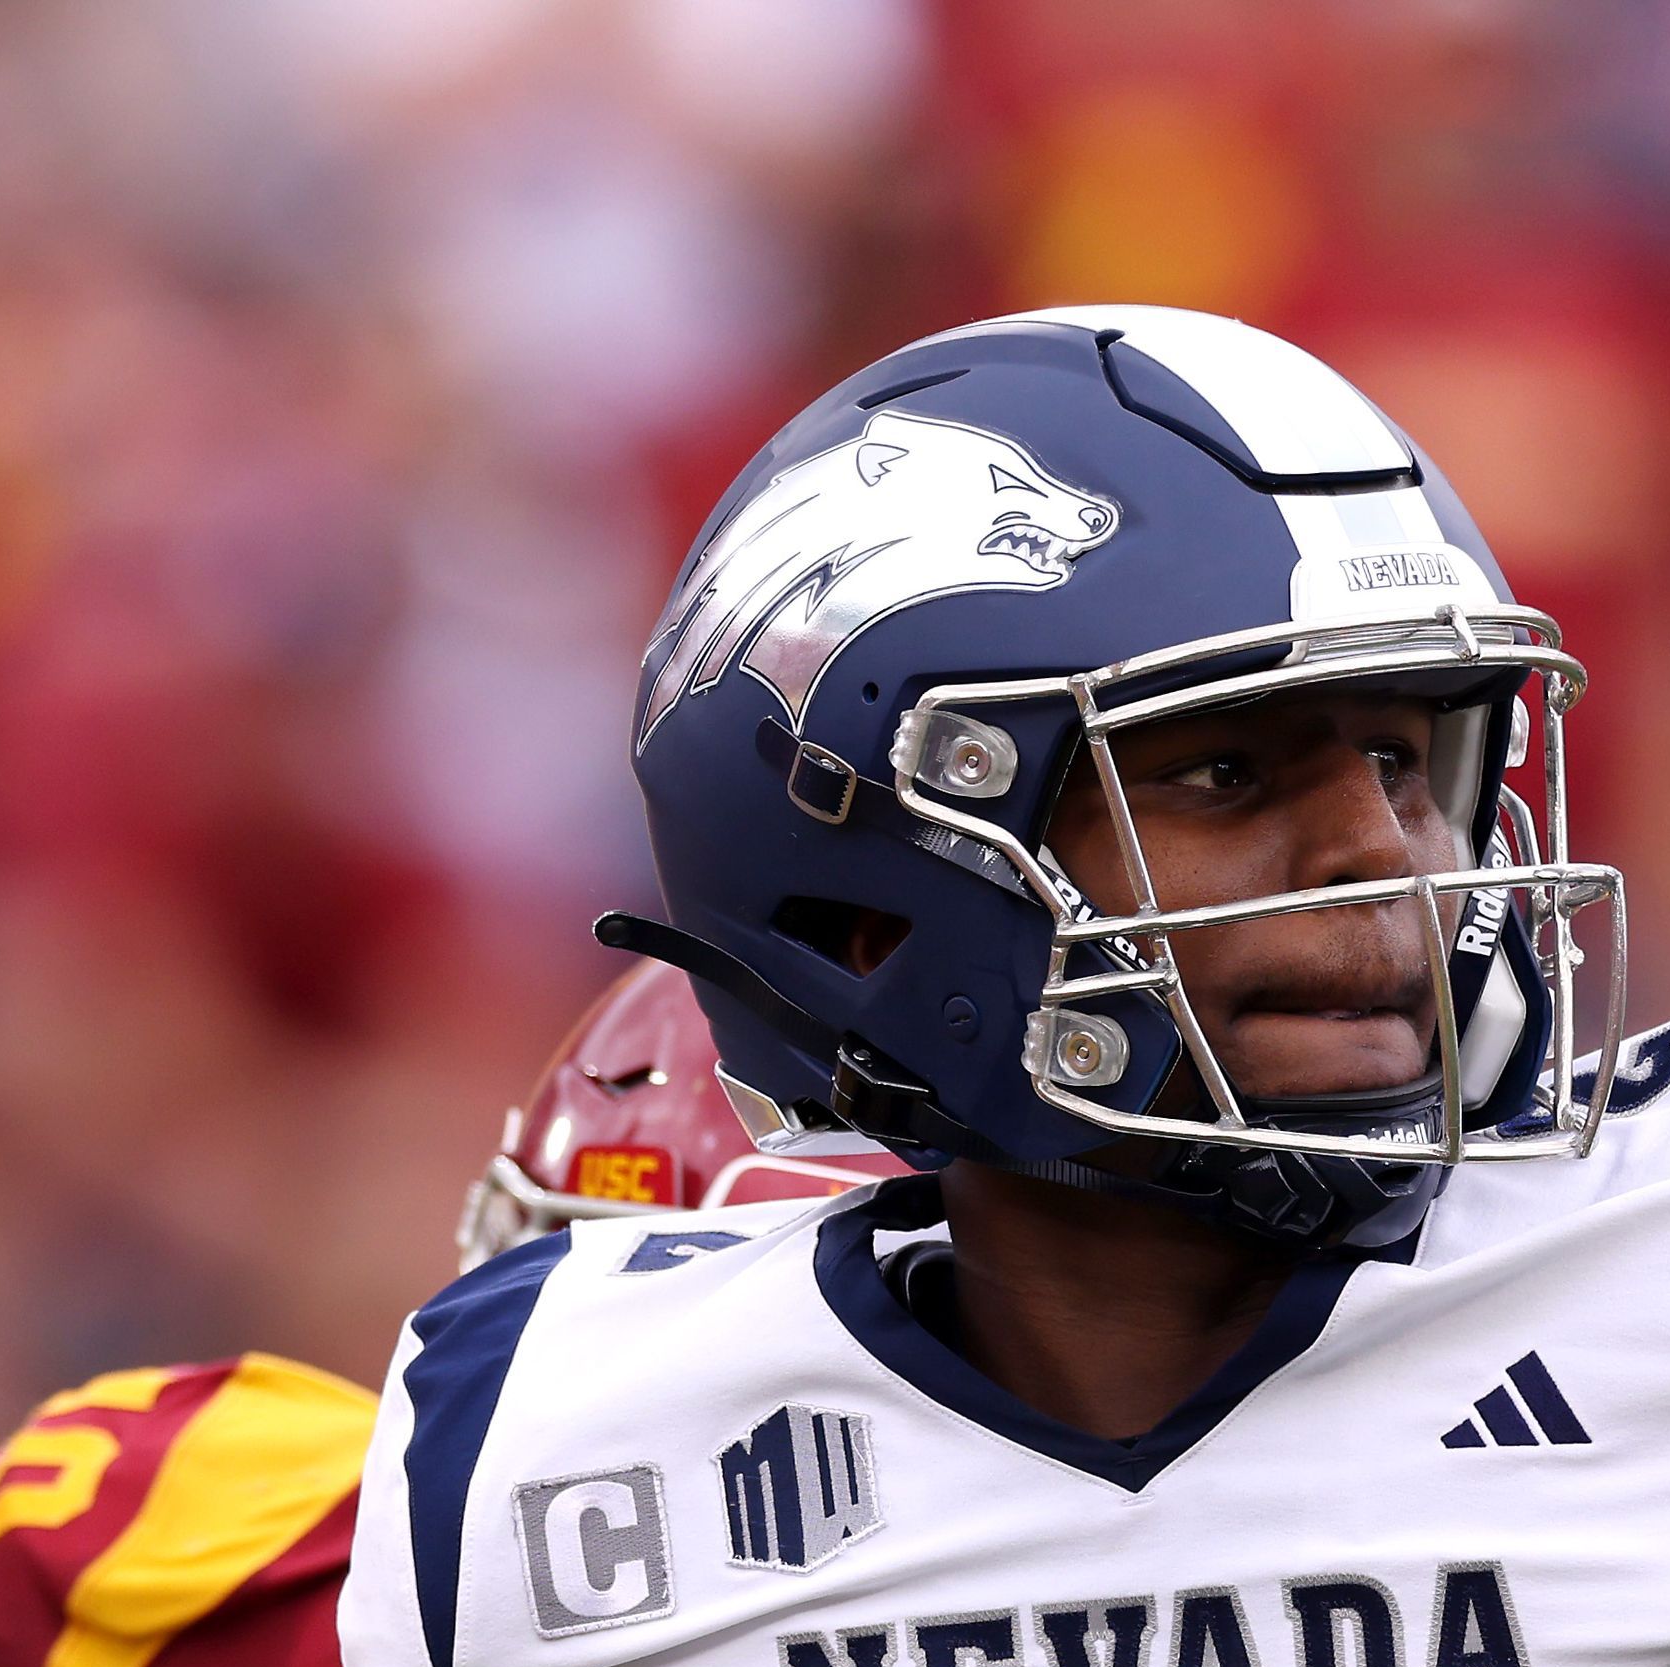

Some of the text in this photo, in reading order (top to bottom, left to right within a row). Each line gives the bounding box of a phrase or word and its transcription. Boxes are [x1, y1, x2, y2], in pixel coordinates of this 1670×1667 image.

[1339, 552, 1460, 592] NEVADA
[1456, 822, 1515, 958] Ridell
[576, 1150, 660, 1202] USC
[545, 1480, 650, 1618] C
